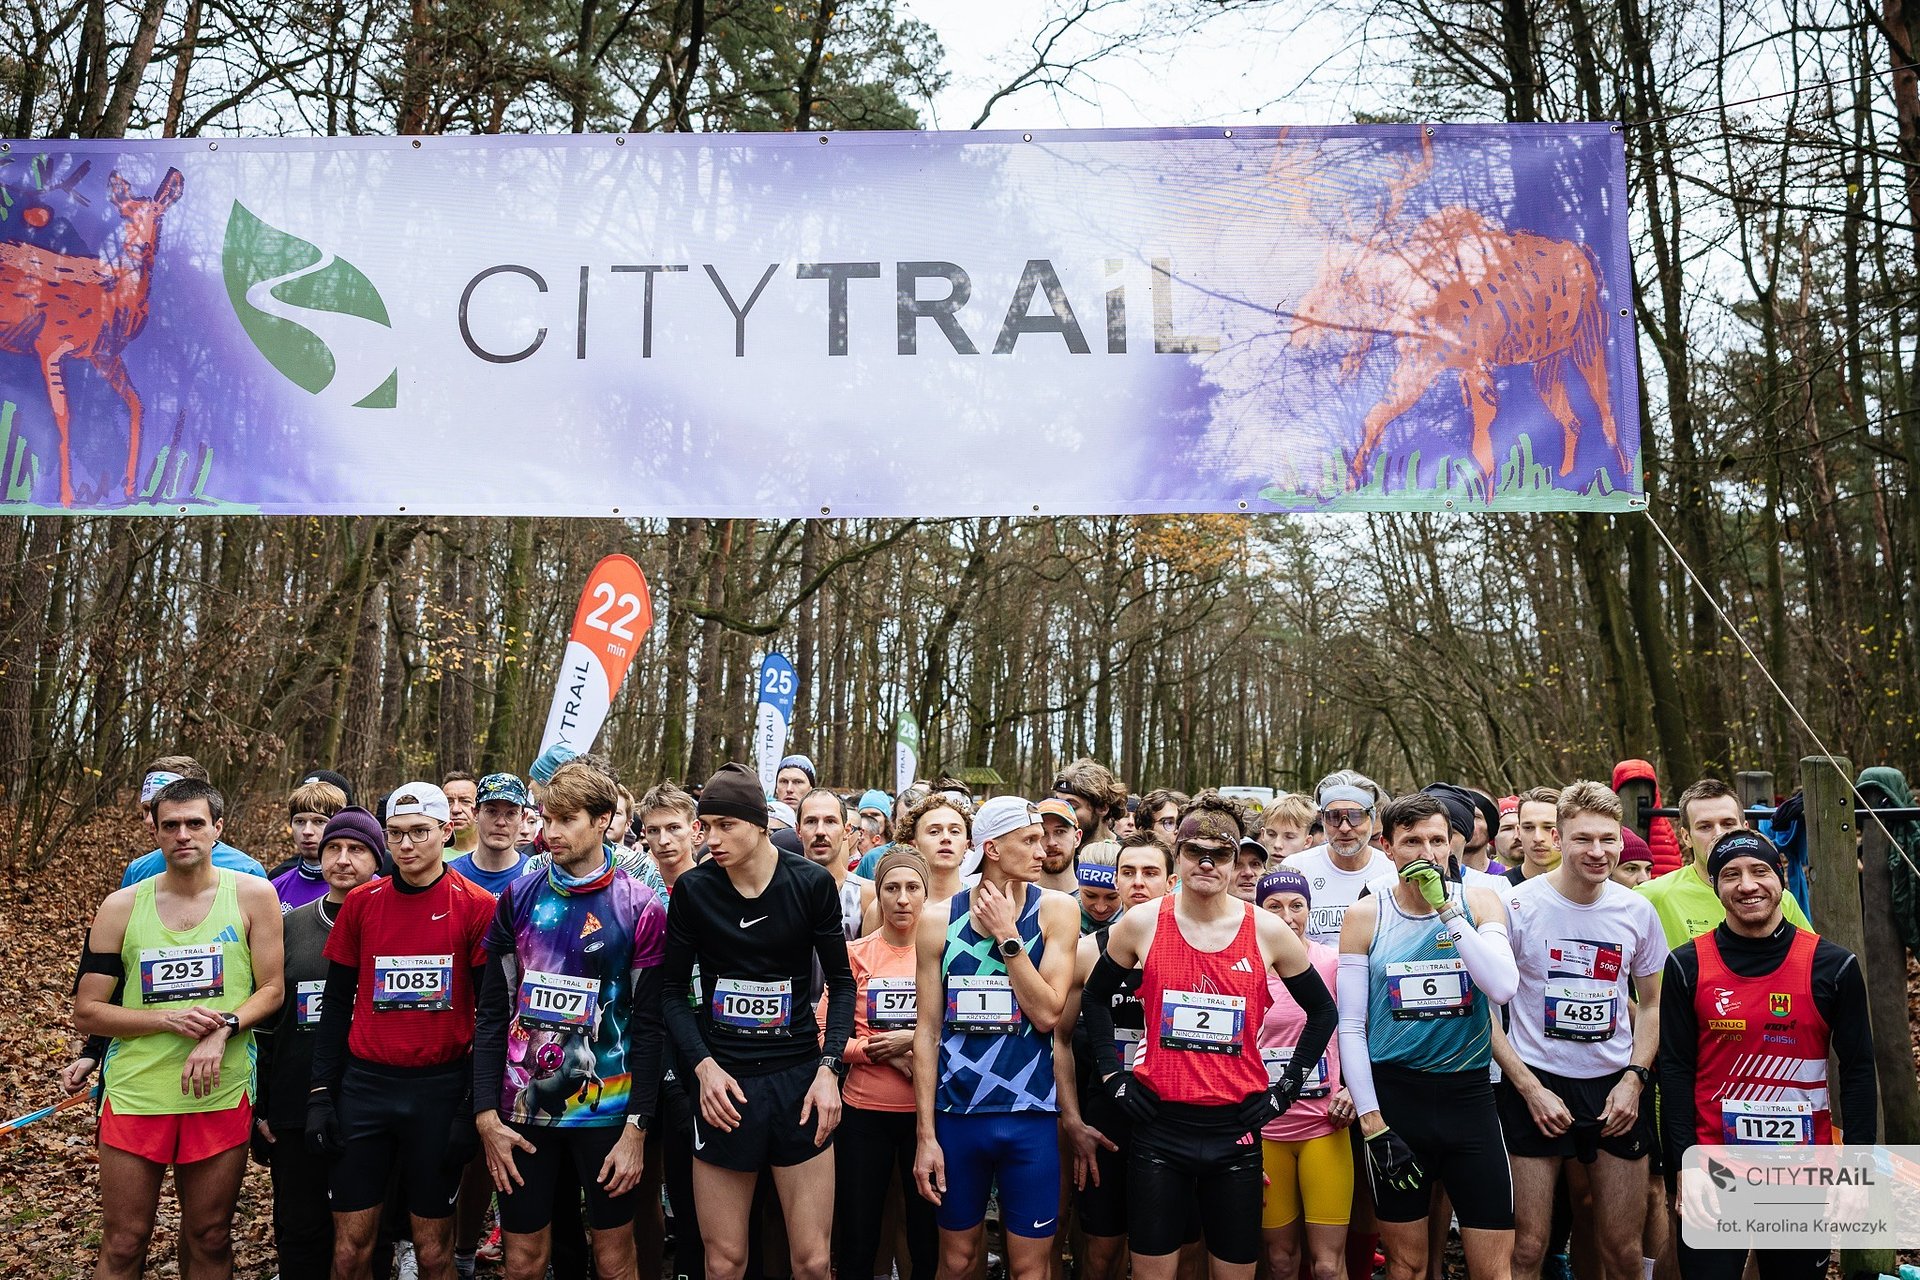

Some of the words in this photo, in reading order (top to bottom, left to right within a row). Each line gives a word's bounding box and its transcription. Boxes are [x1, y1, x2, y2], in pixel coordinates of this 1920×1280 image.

[585, 582, 641, 641] 22
[607, 642, 626, 658] min
[765, 668, 792, 695] 25
[557, 661, 590, 745] YTRAiL
[900, 719, 916, 740] 28
[1263, 876, 1301, 888] KIPRUN
[1308, 909, 1346, 935] KOLA
[160, 961, 204, 981] 293
[1599, 962, 1618, 972] 5000
[387, 972, 439, 990] 1083
[1423, 978, 1437, 996] 6
[535, 989, 582, 1012] 1107
[725, 996, 779, 1016] 1085
[884, 993, 917, 1009] 577
[978, 993, 986, 1010] 1
[1196, 1011, 1210, 1030] 2
[1564, 1004, 1604, 1021] 483
[1710, 1021, 1744, 1029] FANUC
[1763, 1034, 1796, 1045] RollSki
[1742, 1118, 1796, 1139] 1122
